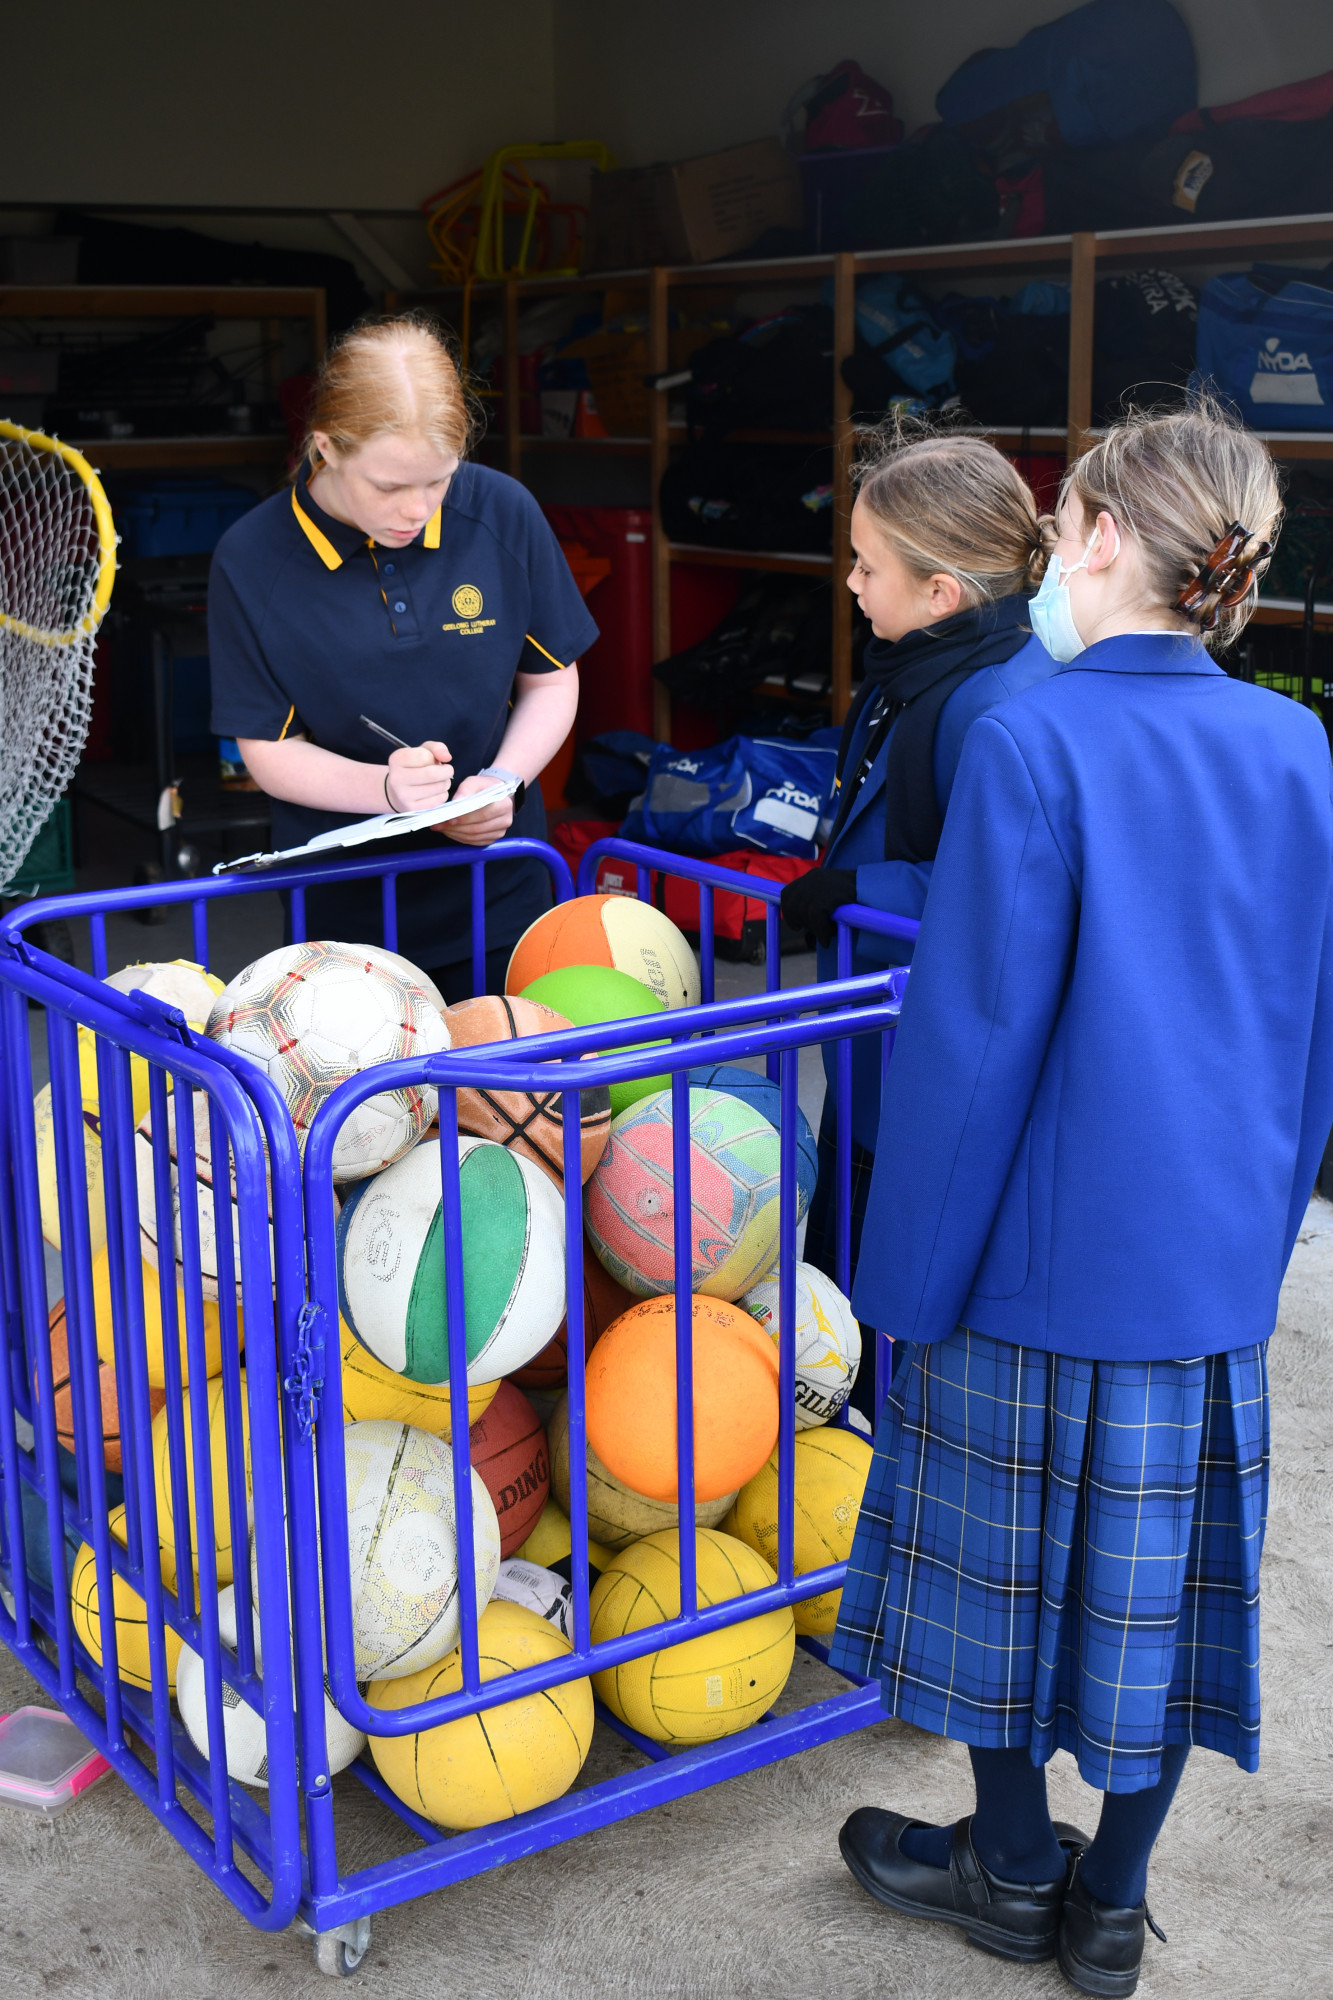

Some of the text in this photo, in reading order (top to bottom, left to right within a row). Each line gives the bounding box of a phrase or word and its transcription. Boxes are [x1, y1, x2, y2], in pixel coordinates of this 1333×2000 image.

[1257, 345, 1313, 372] NYDA
[766, 782, 820, 812] NYDA
[497, 1448, 548, 1515] DING
